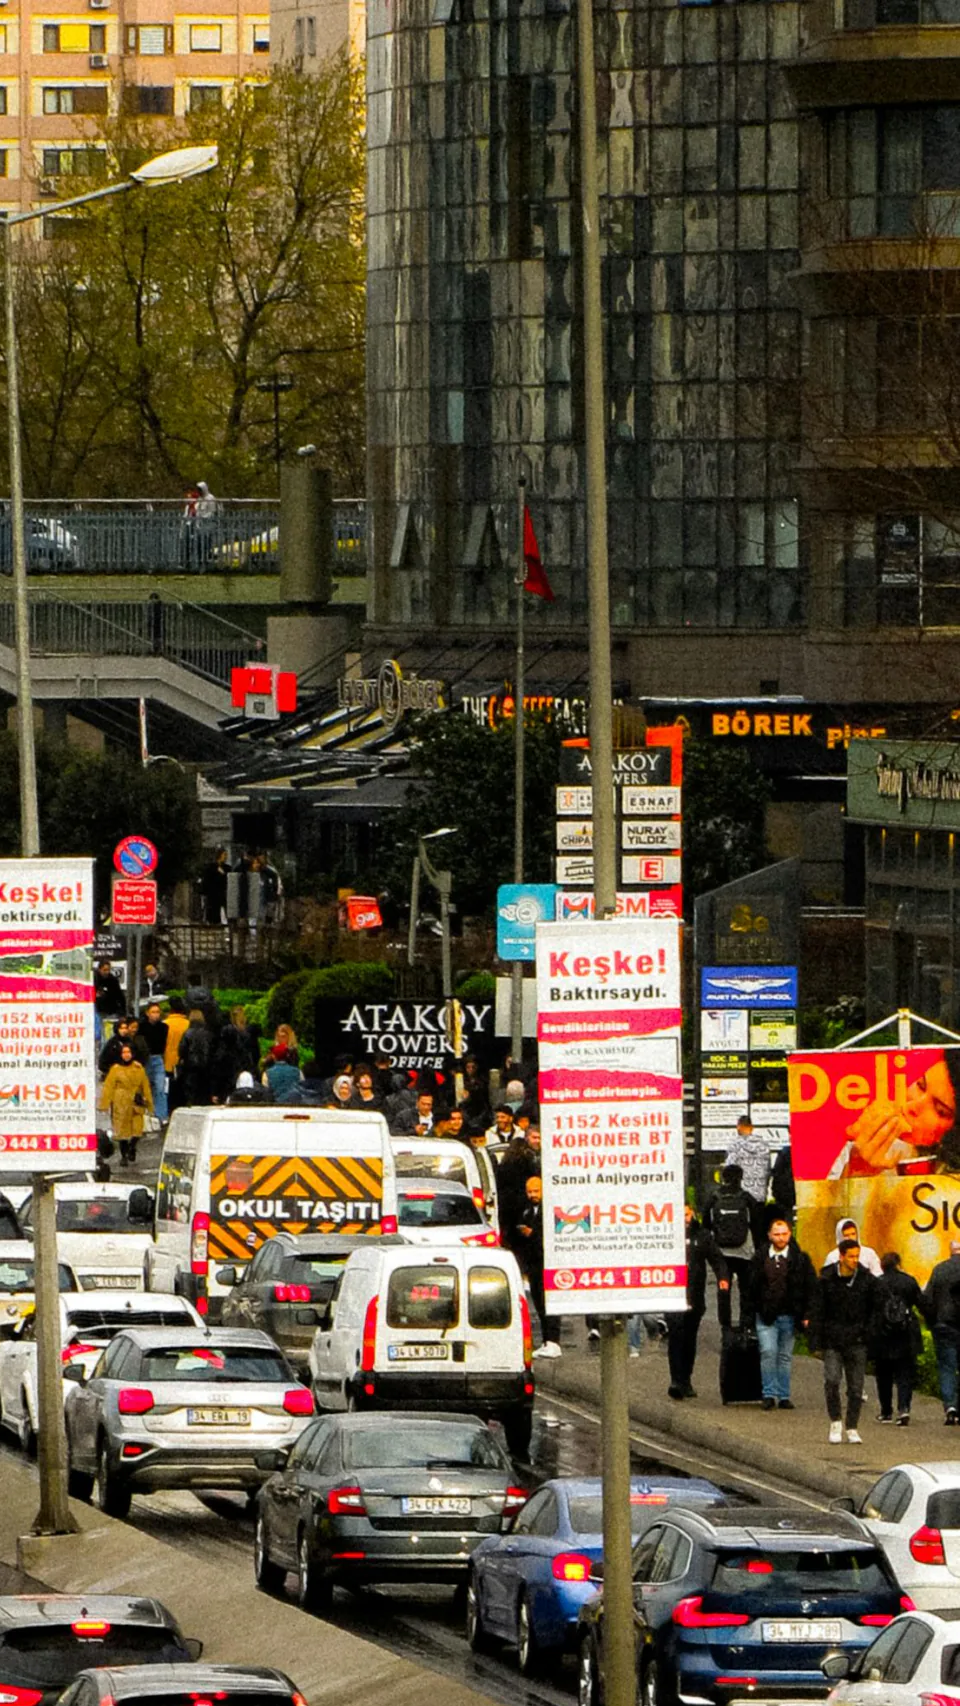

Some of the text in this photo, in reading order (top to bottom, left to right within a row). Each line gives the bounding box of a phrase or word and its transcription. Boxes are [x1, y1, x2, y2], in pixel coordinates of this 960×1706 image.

[712, 710, 813, 736] BÖREK
[630, 797, 674, 806] ESNAF
[627, 826, 668, 835] NURAY
[627, 835, 668, 845] YILDIZ
[549, 949, 667, 983] Keşke!
[550, 985, 667, 1001] Baktırsaydı.
[35, 1012, 84, 1024] Kesitli
[68, 1027, 86, 1039] BT
[542, 1022, 629, 1034] Sevdiklerinize
[362, 1034, 468, 1053] TOWERS
[24, 1059, 87, 1070] Anjiyografi
[789, 1054, 907, 1112] Deli
[23, 1084, 86, 1100] HSM
[554, 1112, 669, 1129] 1152 Kesitli
[9, 1137, 88, 1149] 444 1 800
[552, 1131, 672, 1148] KORONER BT
[559, 1150, 666, 1168] Anjiyografi
[552, 1171, 675, 1185] Sanal Anjiyografi
[220, 1199, 380, 1223] OKUL TAŞITI
[593, 1202, 673, 1225] HSM
[579, 1269, 676, 1286] 444 1 800
[395, 1347, 405, 1357] 34
[193, 1410, 248, 1421] 34 ERA 19
[410, 1498, 420, 1509] 34
[448, 1498, 467, 1509] 422
[770, 1624, 783, 1637] 34
